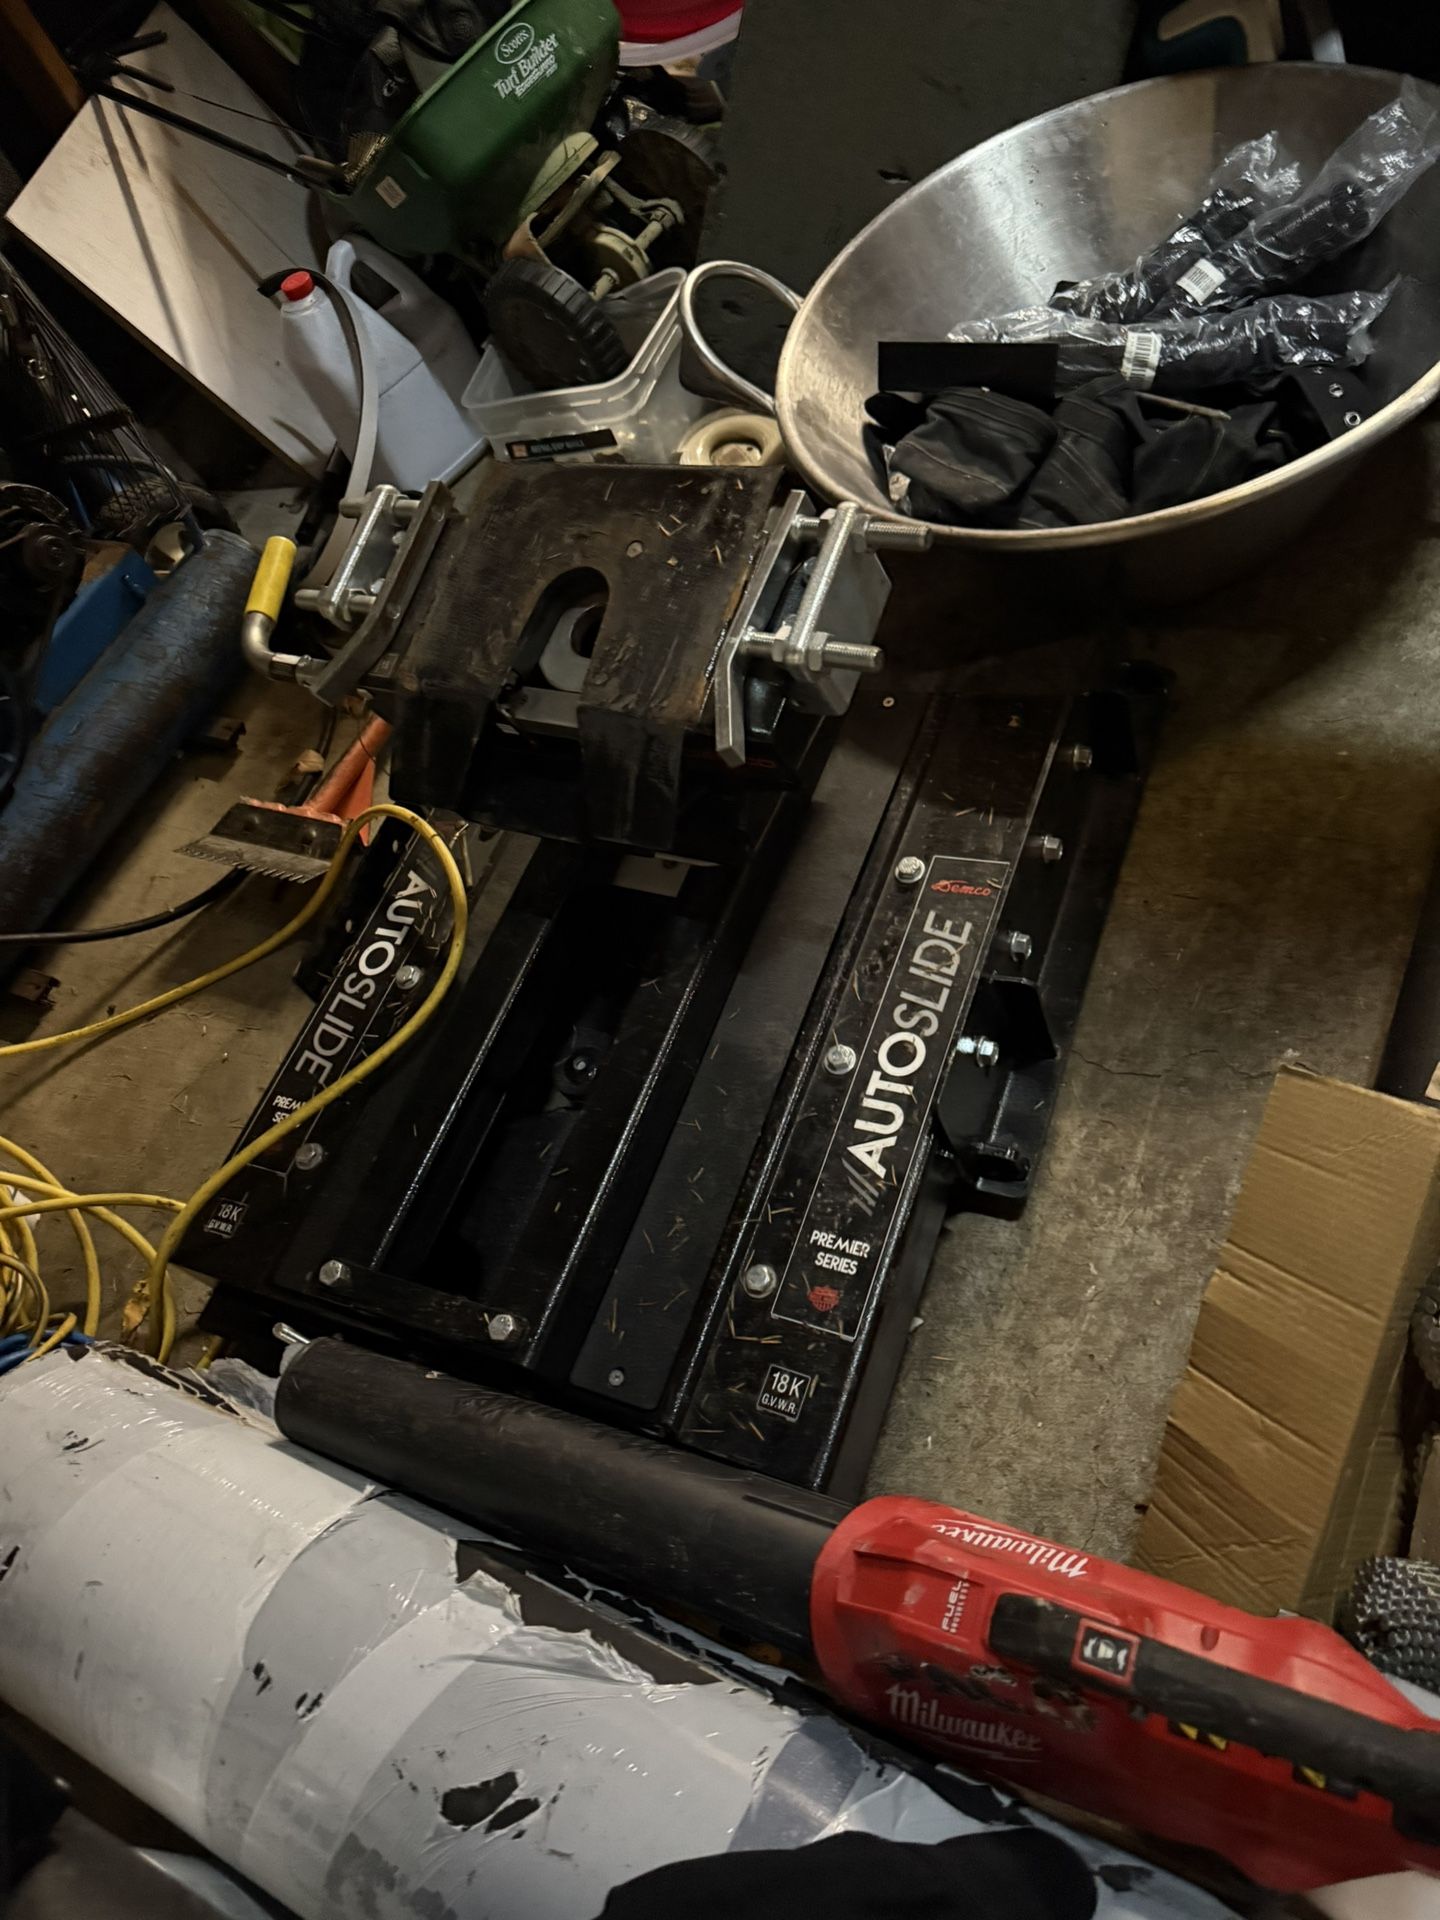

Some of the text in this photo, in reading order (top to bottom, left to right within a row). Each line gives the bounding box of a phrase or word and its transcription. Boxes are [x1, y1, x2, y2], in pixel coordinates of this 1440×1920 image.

[492, 66, 521, 99] Turf
[516, 33, 560, 78] Builder
[295, 870, 431, 1087] AUTOSLIDE
[846, 910, 973, 1179] AUTOSLIDE
[272, 1095, 306, 1110] PREM
[809, 1230, 870, 1259] PREMIER
[814, 1251, 858, 1275] SERIES
[761, 1393, 797, 1415] G.V.W.R.
[931, 1524, 1089, 1579] Milwaukee
[940, 1580, 963, 1632] FUEL
[885, 1683, 1042, 1750] Milwaukee
